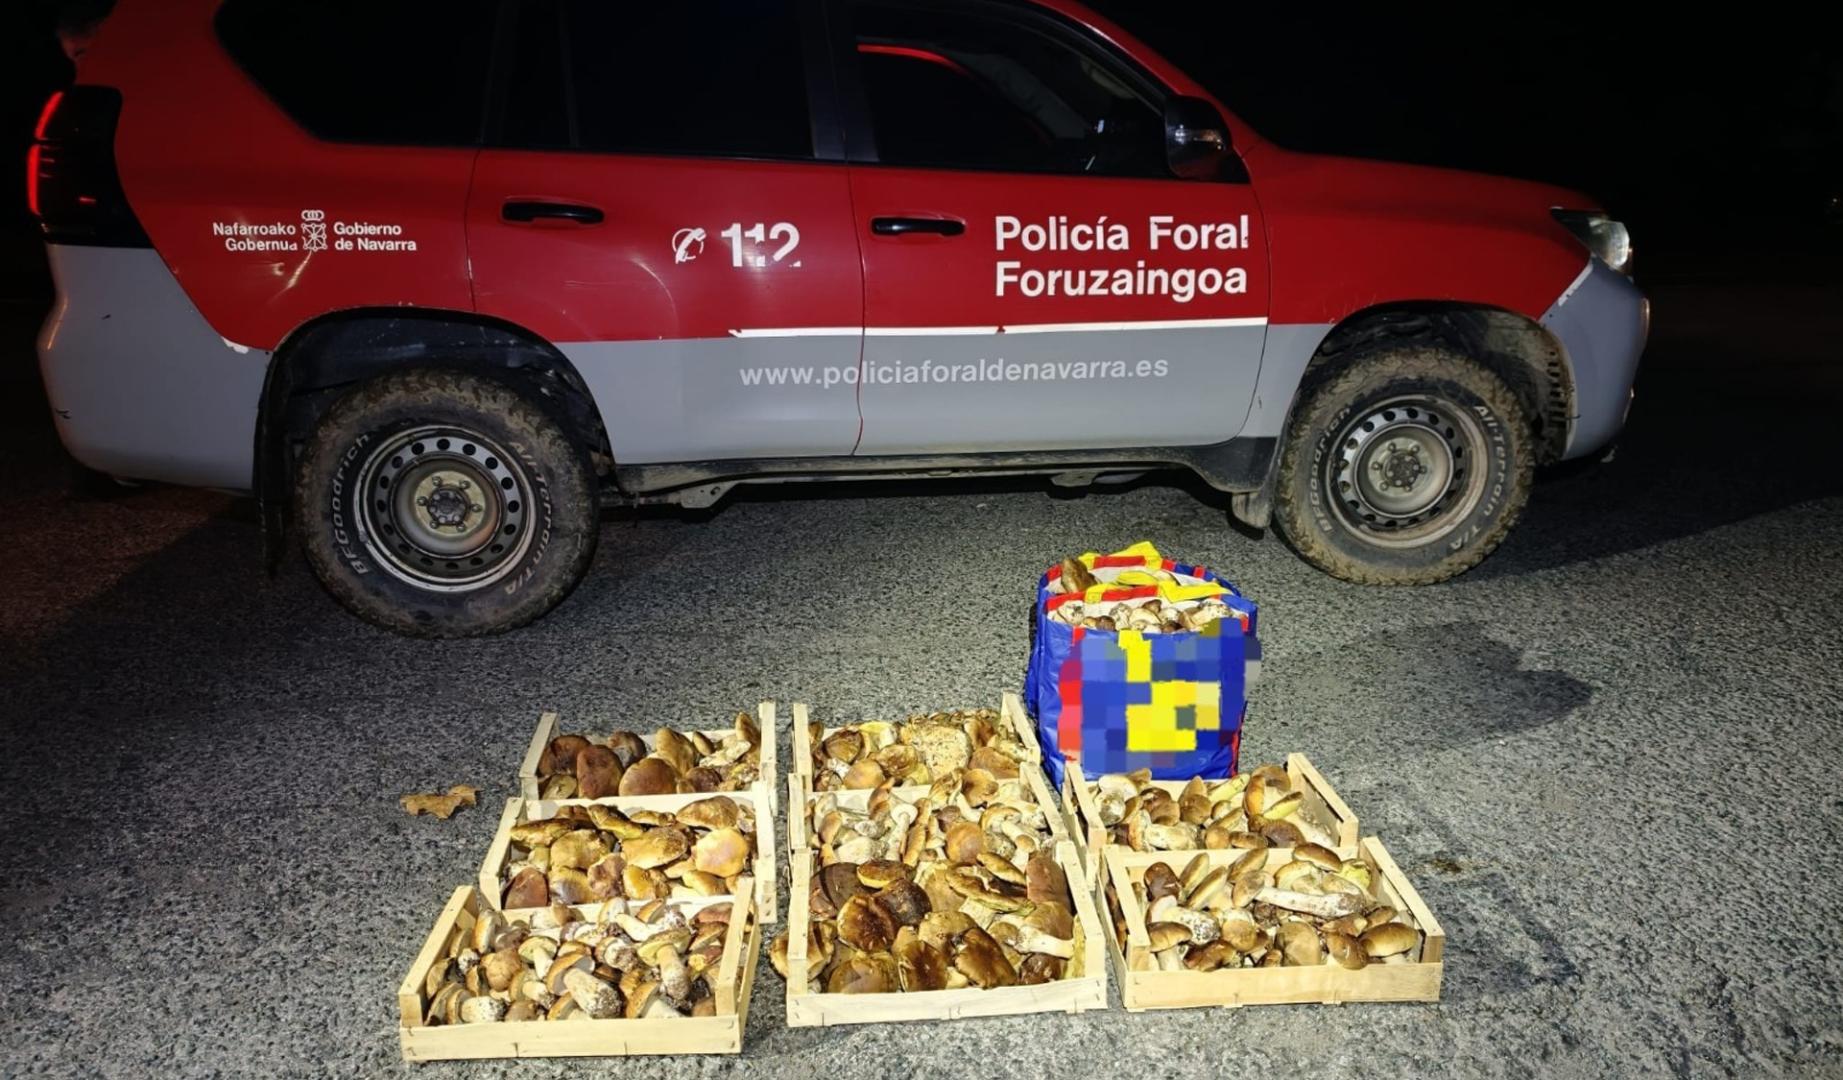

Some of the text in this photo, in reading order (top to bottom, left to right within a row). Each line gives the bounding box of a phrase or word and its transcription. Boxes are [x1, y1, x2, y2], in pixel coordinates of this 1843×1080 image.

[213, 222, 297, 236] Nafarroako
[333, 222, 403, 236] Gobierno
[335, 238, 417, 252] de Navarra
[721, 222, 802, 268] 112
[995, 214, 1249, 251] Policía Foral
[995, 261, 1248, 303] Foruzaingoa
[739, 356, 1170, 388] www.policiaforaldenavarra.es
[331, 434, 369, 575] BFGoodrich
[508, 441, 552, 565] AllTerrain
